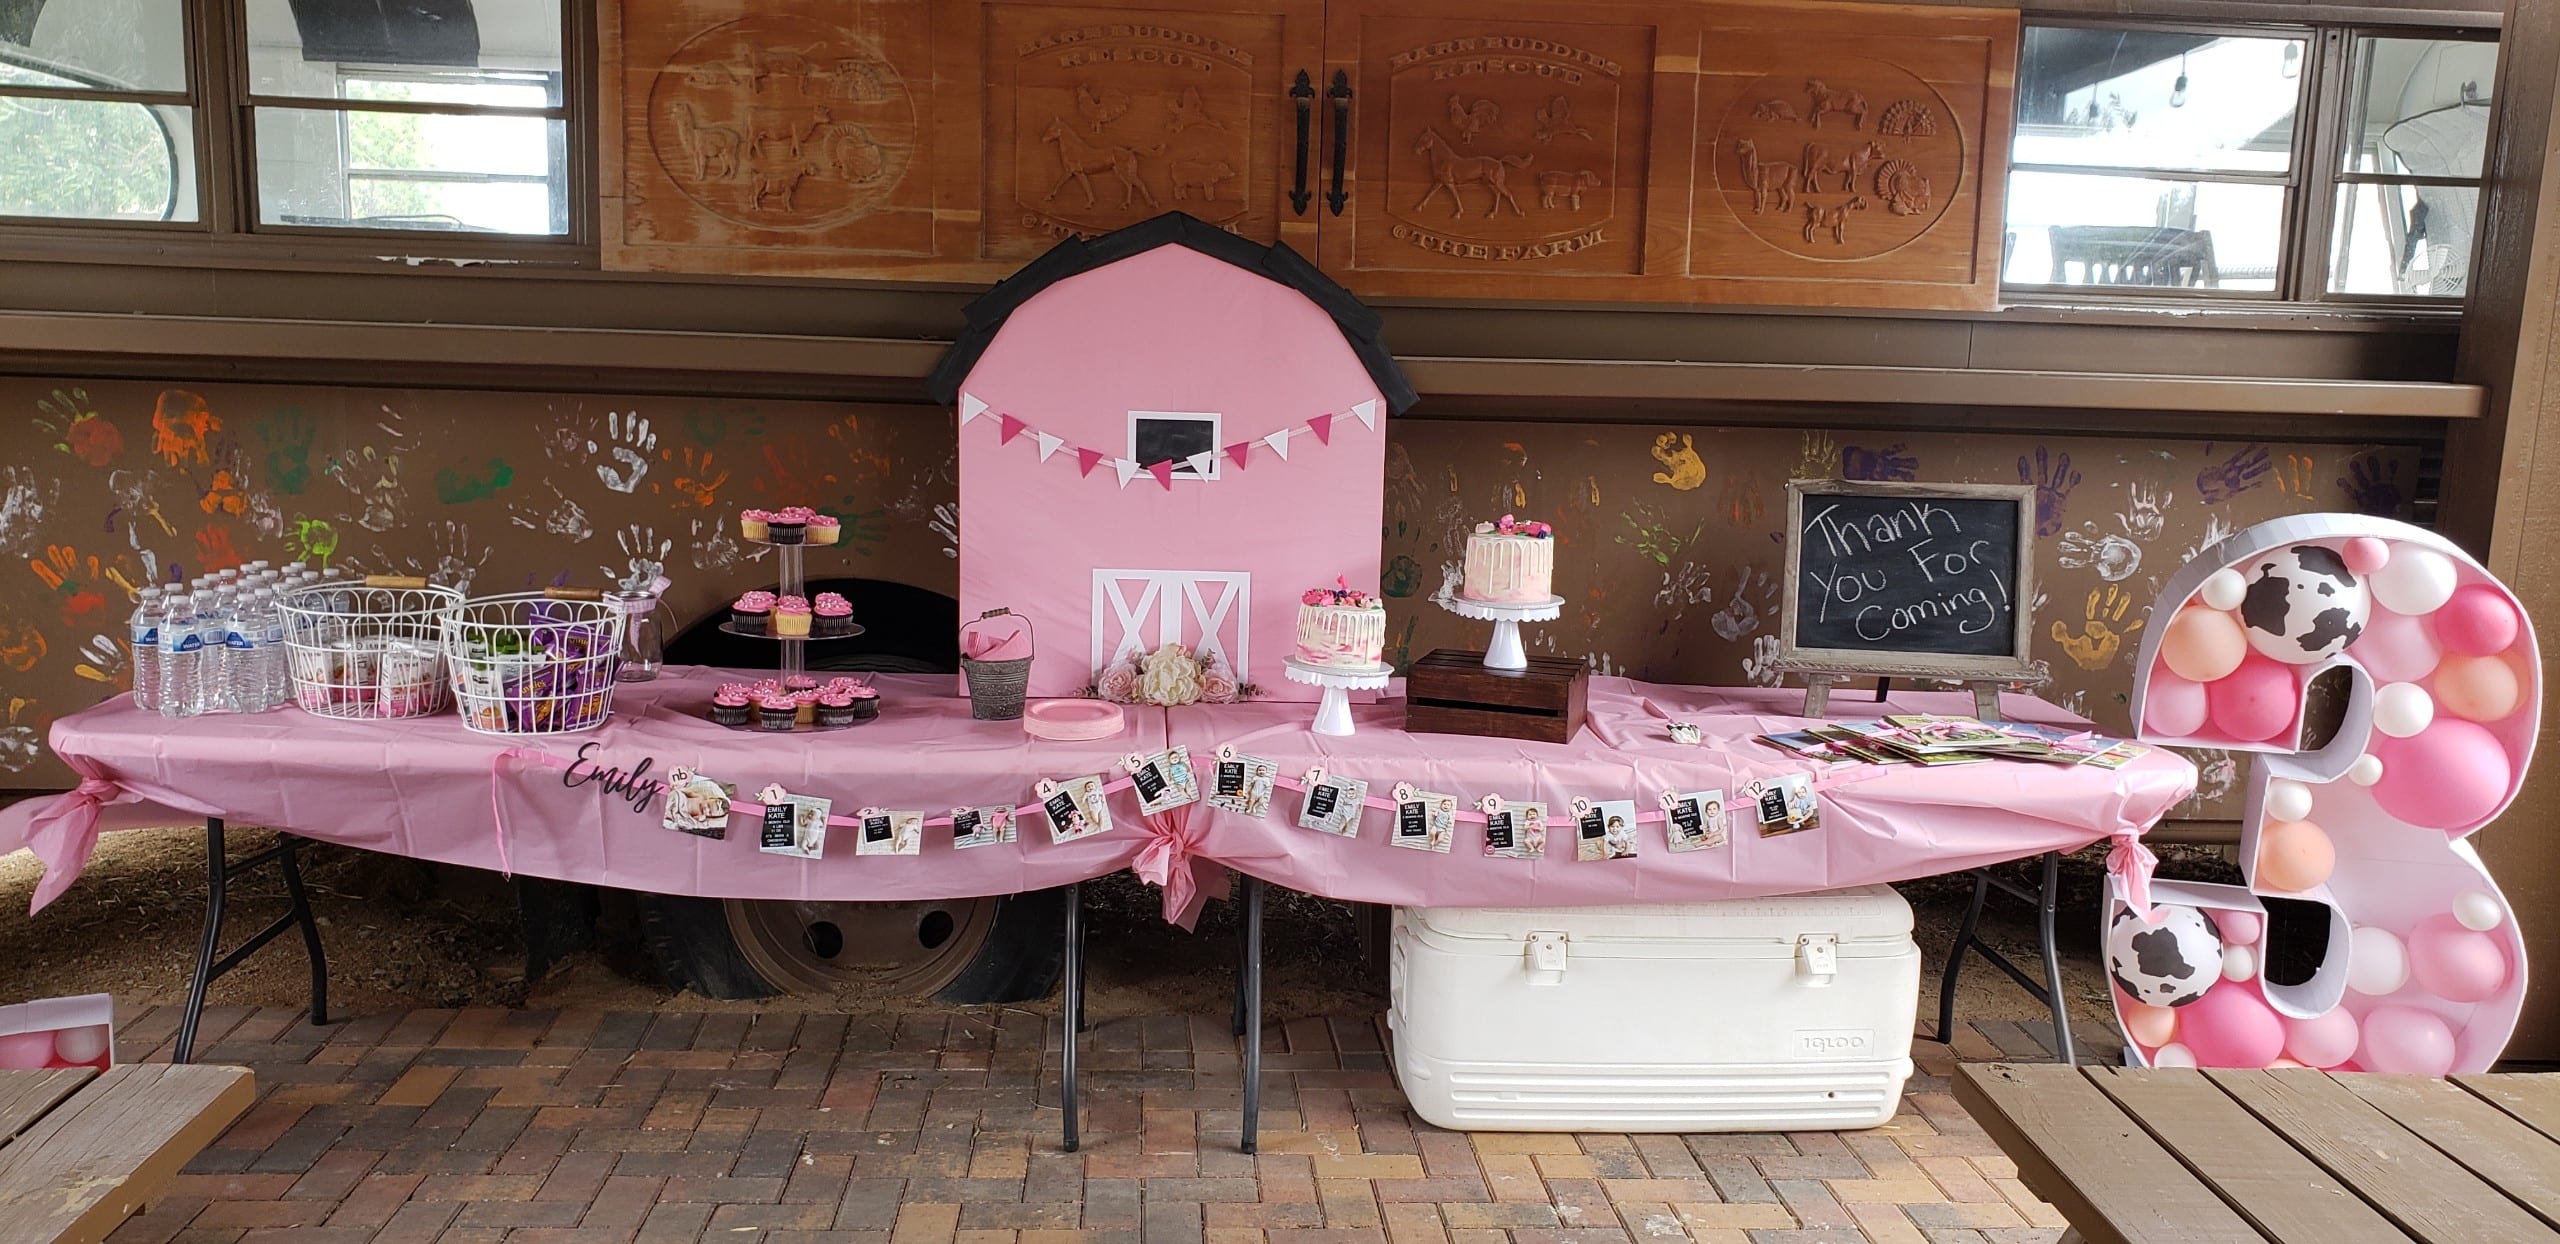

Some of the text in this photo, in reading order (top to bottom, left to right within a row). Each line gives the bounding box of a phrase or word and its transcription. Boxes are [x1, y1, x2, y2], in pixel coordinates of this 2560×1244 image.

[1495, 228, 1608, 261] FARM
[1803, 501, 1962, 557] Thank
[1906, 537, 1990, 583] For
[1855, 568, 2011, 641] Coming!
[1223, 746, 1231, 758] 6
[1130, 756, 1141, 768] 5
[563, 741, 665, 814] Emily
[672, 768, 687, 782] nb
[1312, 769, 1321, 782] 7
[771, 789, 778, 800] 1
[1043, 783, 1051, 793] 4
[1399, 788, 1409, 800] 8
[1749, 781, 1765, 795] 12
[1488, 798, 1496, 810] 9
[1572, 799, 1588, 813] 10
[1662, 793, 1675, 806] 11
